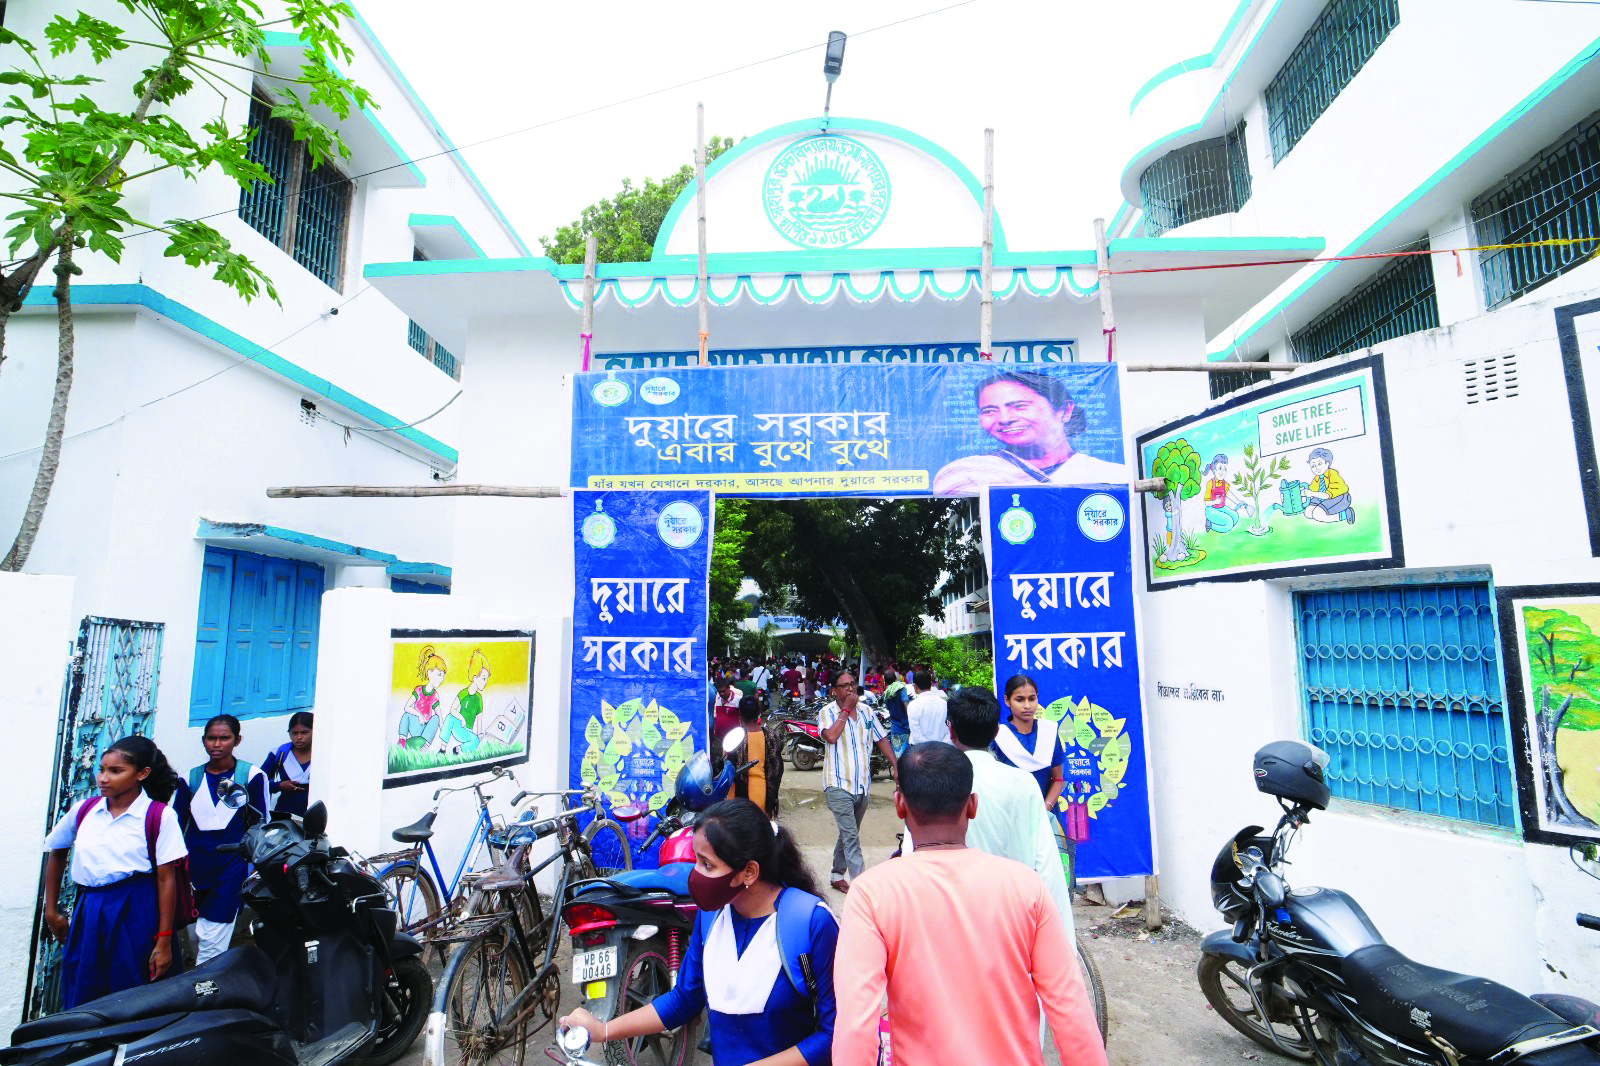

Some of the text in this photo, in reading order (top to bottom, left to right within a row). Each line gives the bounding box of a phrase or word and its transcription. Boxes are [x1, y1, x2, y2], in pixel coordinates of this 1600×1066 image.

[645, 385, 665, 393] দুয়ারে
[1272, 410, 1298, 428] SAVE
[624, 409, 891, 448] দুয়ারে সরকার
[1275, 428, 1302, 446] SAVE
[657, 437, 891, 468] এবার বুথে বুথে
[594, 475, 923, 489] যাঁর যখন যেখানে দরকার, আসছে আপনার দুয়ারে সরকার
[664, 514, 687, 527] দুয়ারে
[1084, 507, 1107, 520] দুয়ারে
[672, 526, 696, 534] সরকার
[1092, 518, 1118, 527] সরকার
[590, 577, 690, 624] দুয়ারে
[1009, 571, 1114, 621] দুয়ারে
[582, 636, 697, 673] সরকার
[1004, 631, 1126, 670] সরকার
[1068, 758, 1091, 769] দুয়ারে
[1069, 768, 1092, 776] সরকার
[584, 950, 610, 966] WB 66
